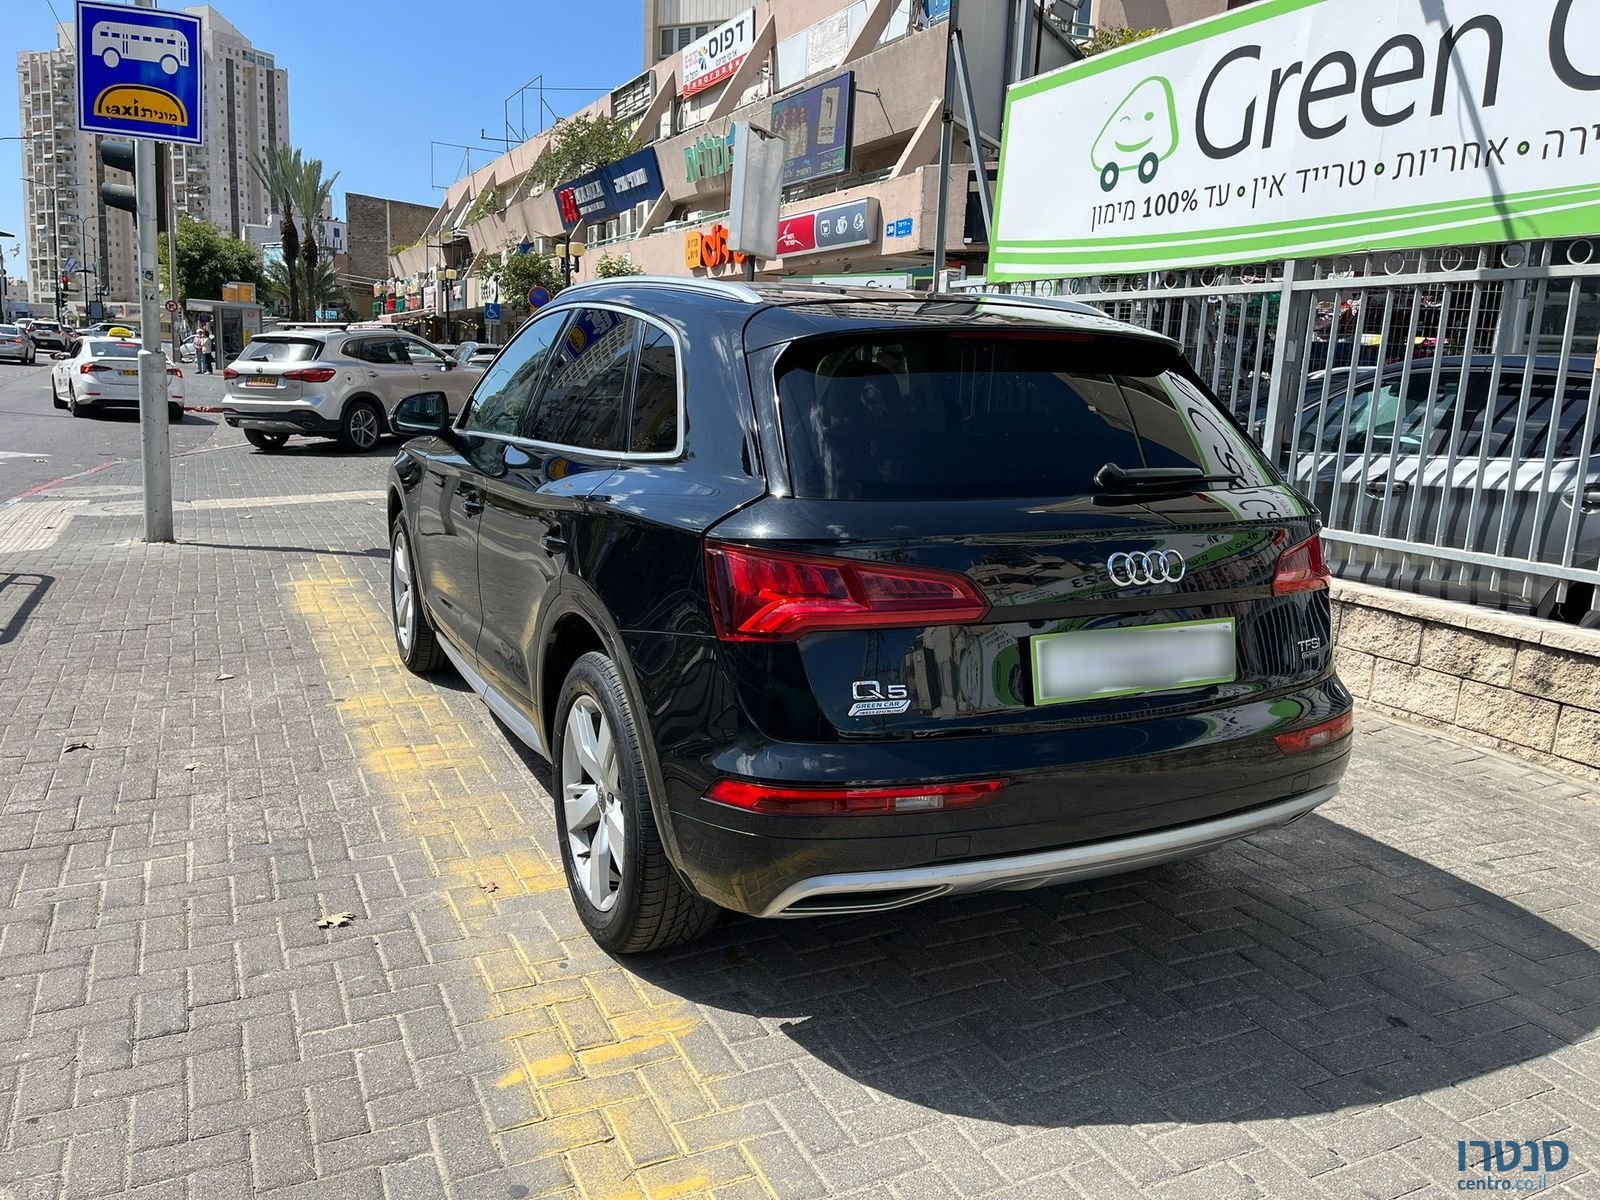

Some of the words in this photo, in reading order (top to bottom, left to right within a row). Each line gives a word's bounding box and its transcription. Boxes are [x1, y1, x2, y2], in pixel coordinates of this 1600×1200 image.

[709, 20, 745, 59] דפוס
[1195, 14, 1504, 160] Green
[105, 98, 139, 117] taxi
[140, 107, 178, 121] מונית
[1392, 136, 1510, 180] אחריות
[1251, 172, 1287, 209] אין
[1296, 159, 1366, 193] טרייד
[1142, 188, 1198, 218] 100%
[1204, 183, 1231, 208] עד
[1091, 200, 1136, 232] מימון
